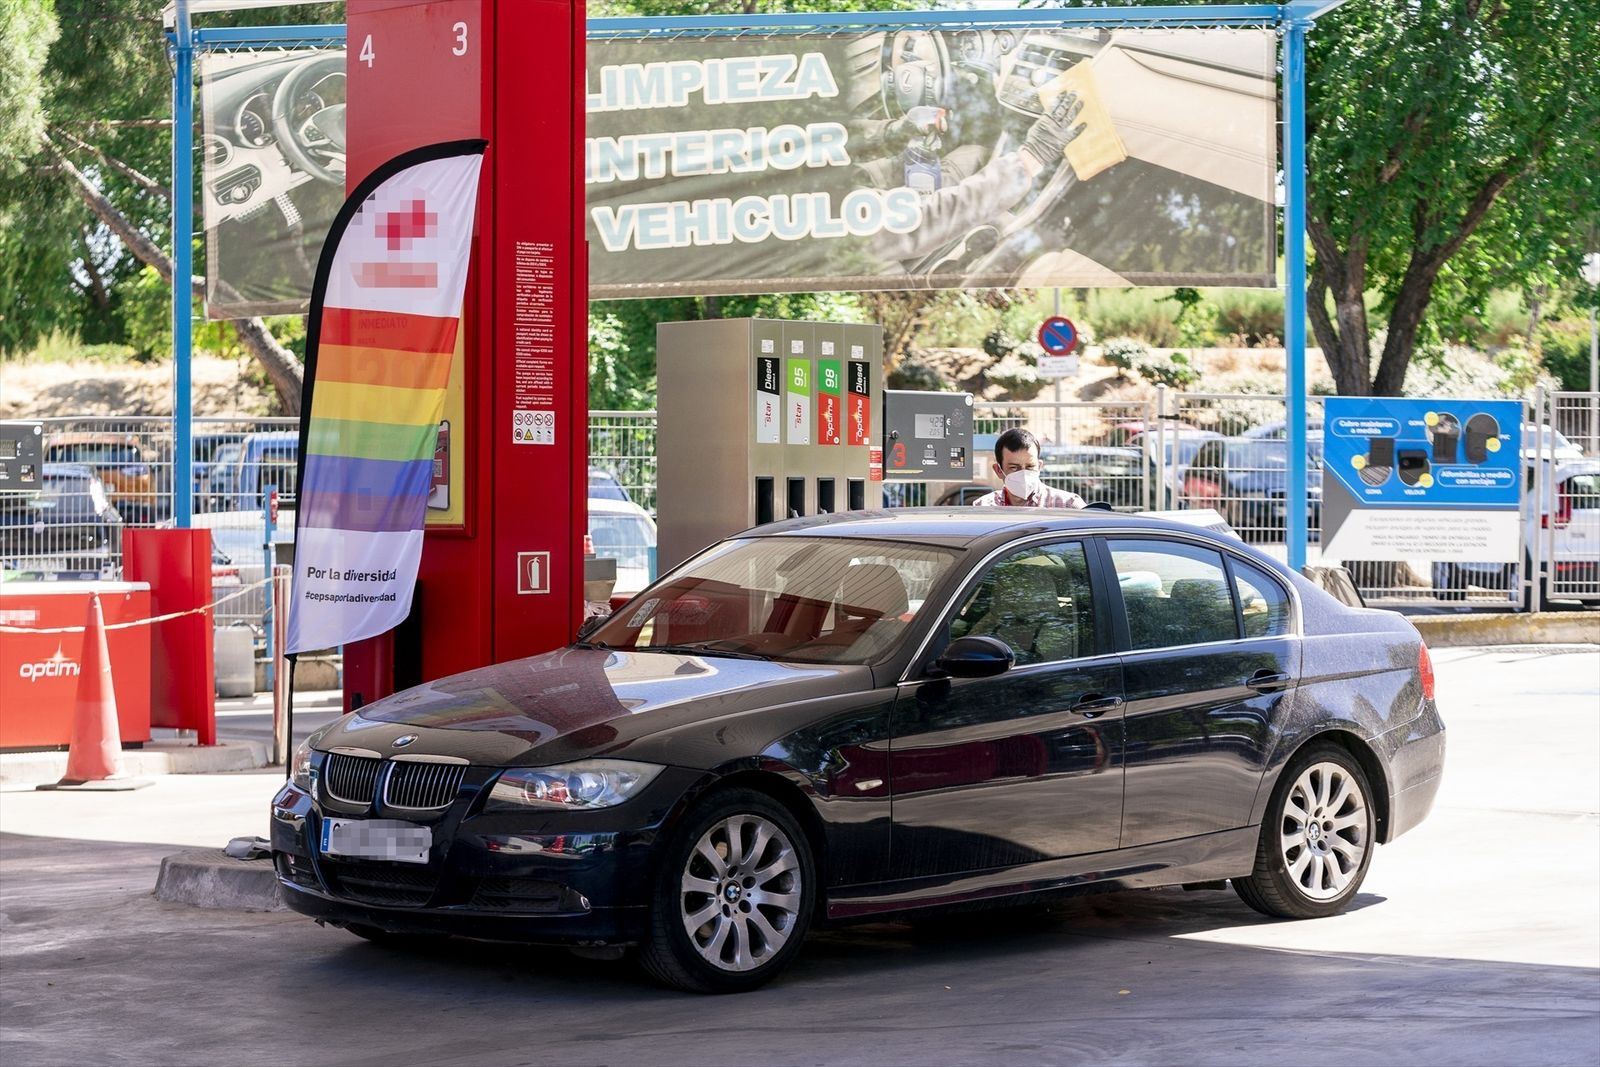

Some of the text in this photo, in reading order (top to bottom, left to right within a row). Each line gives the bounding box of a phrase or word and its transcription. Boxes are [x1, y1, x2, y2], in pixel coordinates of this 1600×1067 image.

[359, 34, 375, 68] 4
[452, 22, 467, 56] 3
[585, 122, 851, 184] INTERIOR
[591, 187, 923, 251] VEHICULOS
[764, 359, 772, 390] Diesel
[795, 367, 804, 387] 95
[825, 368, 835, 388] 98
[893, 442, 906, 468] 3
[307, 567, 326, 579] Por
[329, 568, 340, 580] la
